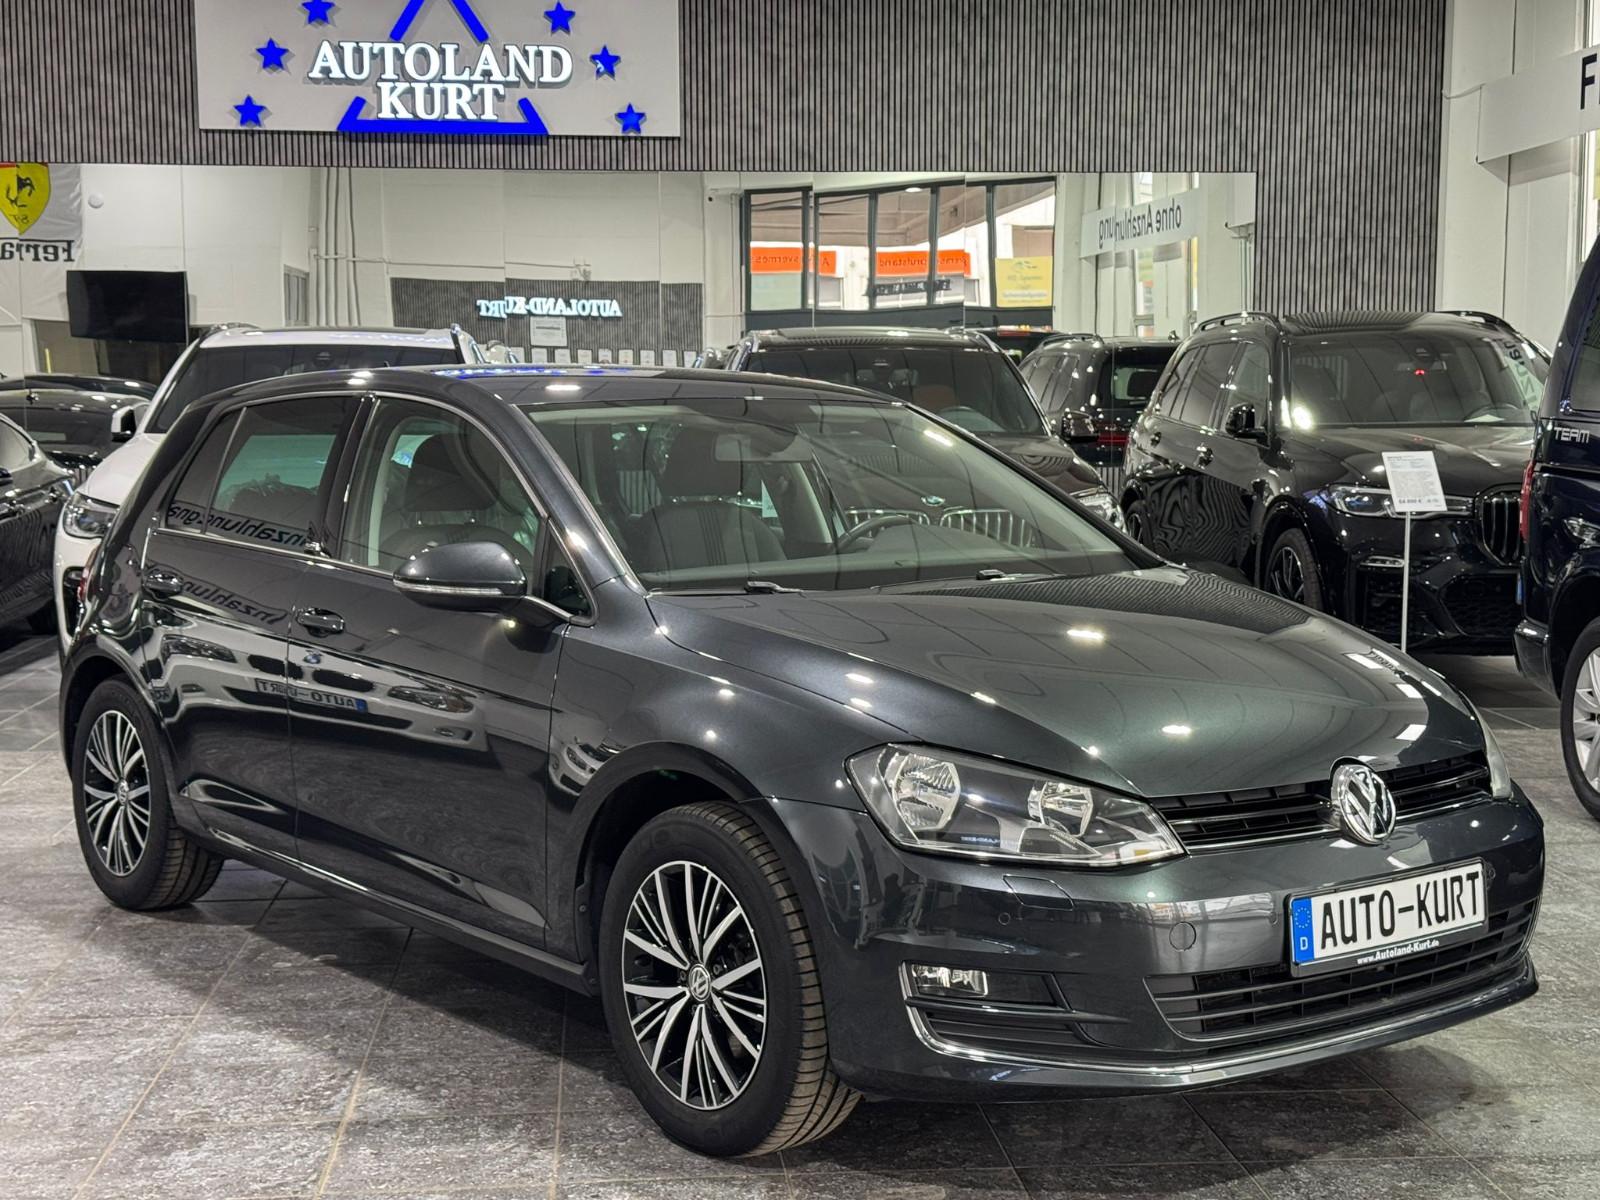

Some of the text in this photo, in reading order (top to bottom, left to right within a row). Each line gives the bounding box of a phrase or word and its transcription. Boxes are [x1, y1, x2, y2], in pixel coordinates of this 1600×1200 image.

[308, 40, 573, 83] AUTOLAND
[376, 82, 505, 120] KURT
[1554, 426, 1590, 443] TEAM
[1299, 871, 1480, 951] D AUTO-KURT
[1356, 938, 1441, 965] www.Autoland-Kurt.de
